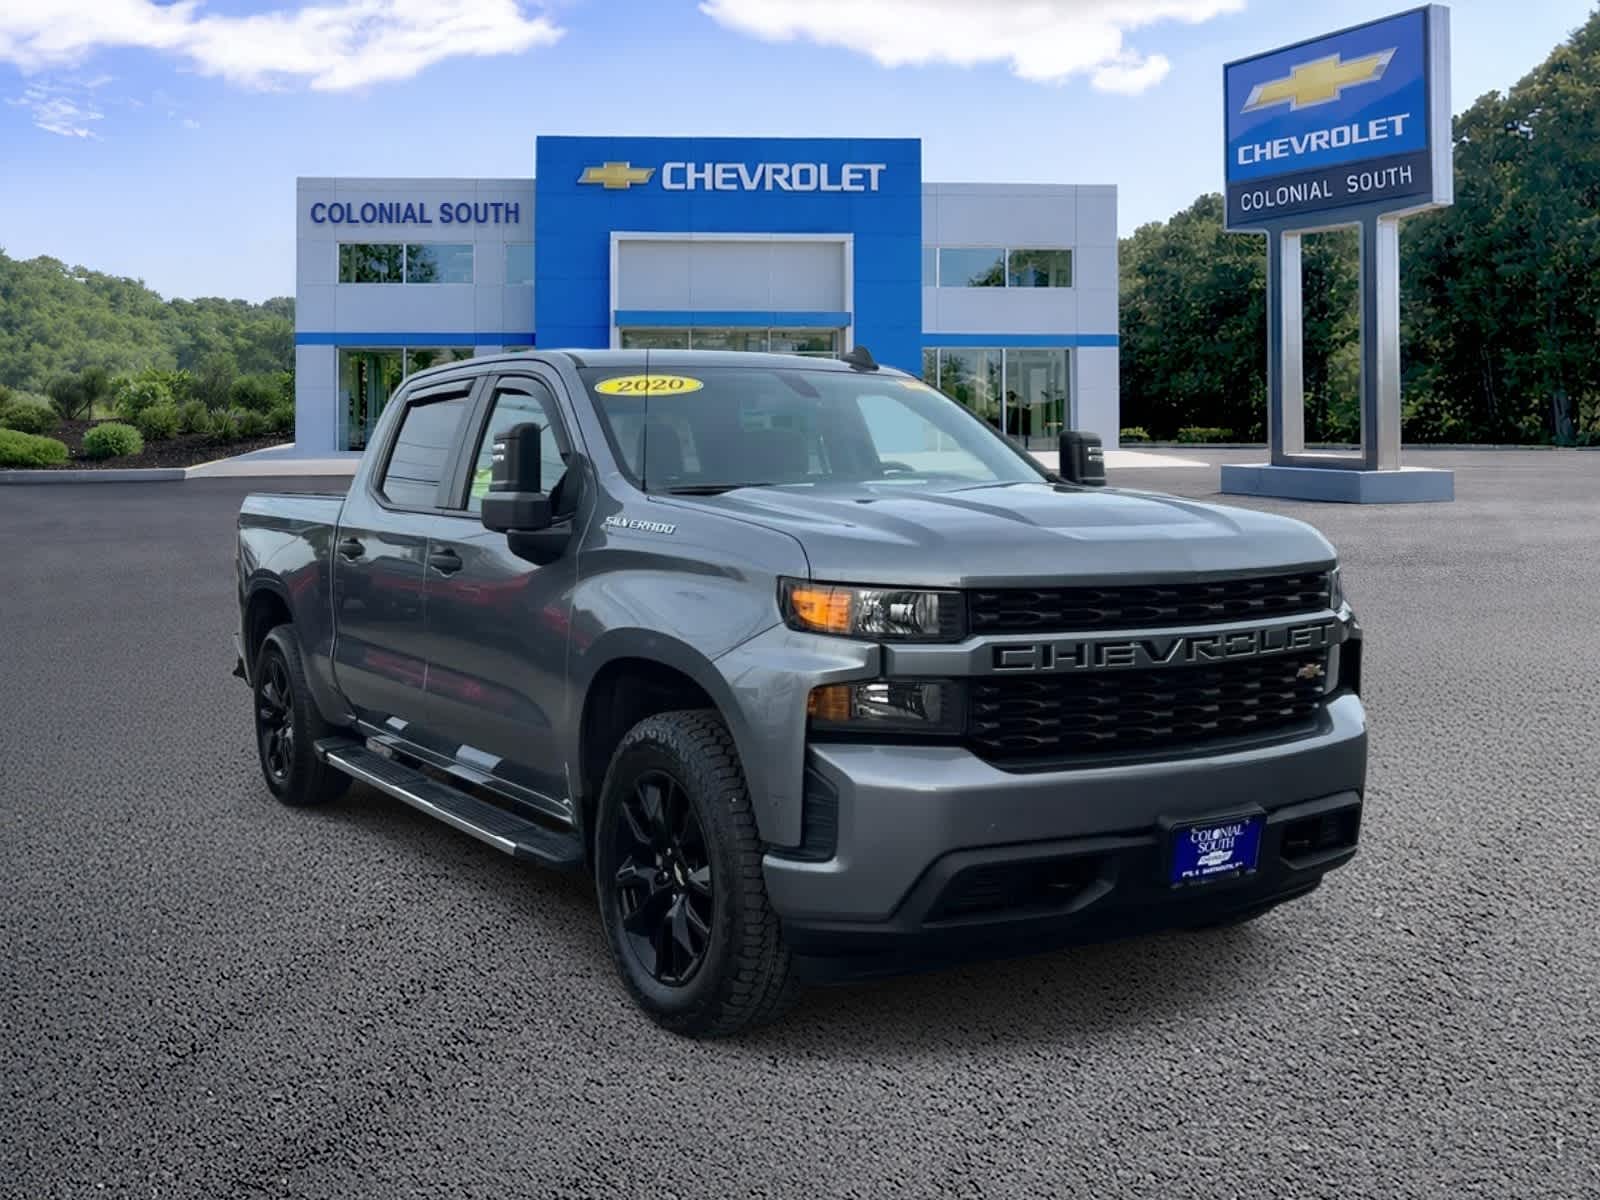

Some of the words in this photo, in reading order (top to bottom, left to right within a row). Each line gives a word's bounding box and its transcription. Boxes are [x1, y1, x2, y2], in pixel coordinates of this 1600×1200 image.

[1237, 113, 1410, 165] CHEVROLET
[661, 161, 887, 192] CHEVROLET
[1240, 179, 1333, 211] COLONIAL
[1346, 165, 1412, 194] SOUTH
[310, 202, 433, 224] COLONIAL
[439, 202, 520, 224] SOUTH
[616, 378, 685, 392] 2020
[605, 516, 676, 535] SILVERADO
[992, 623, 1336, 671] CHEVROLET
[1190, 824, 1244, 843] COLONIAL
[1197, 837, 1235, 853] SOUTH
